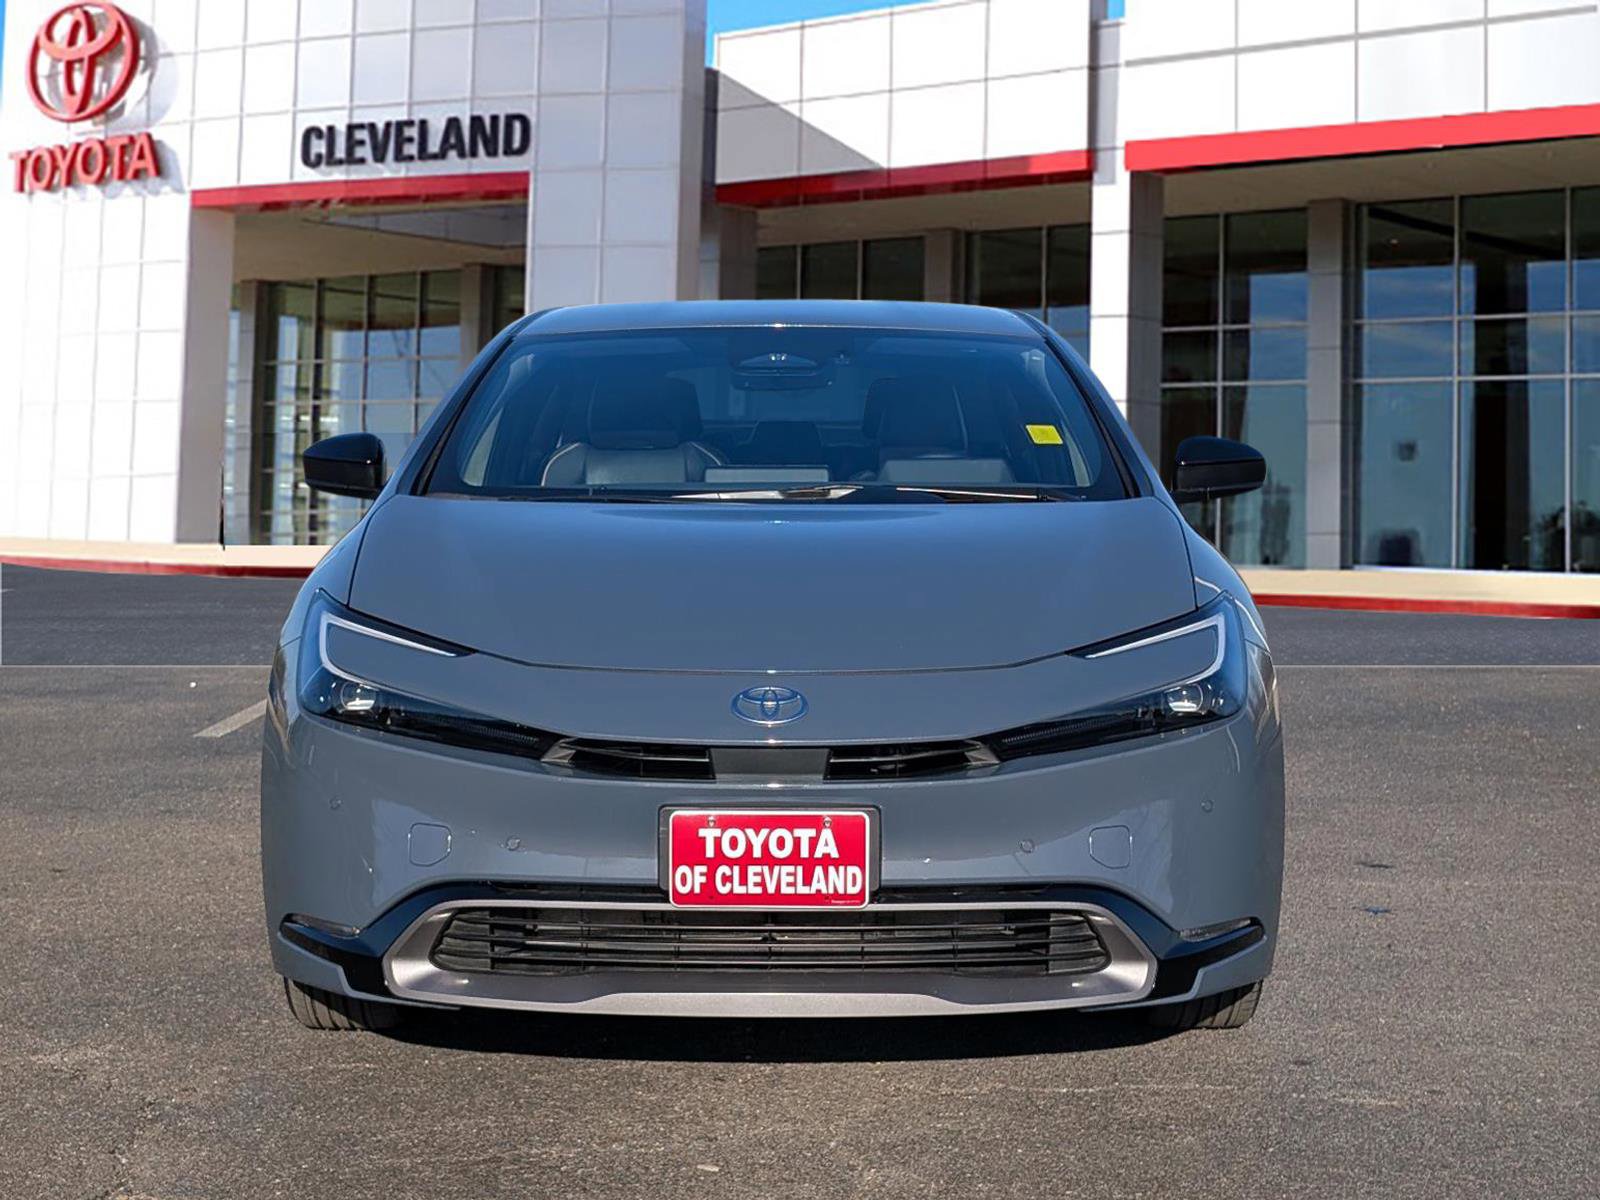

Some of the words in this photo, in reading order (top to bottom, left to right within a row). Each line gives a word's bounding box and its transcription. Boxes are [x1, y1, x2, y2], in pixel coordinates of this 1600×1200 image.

[9, 131, 162, 193] TOYOTA
[300, 112, 531, 169] CLEVELAND
[698, 827, 840, 859] TOYOTA
[674, 864, 708, 895] OF
[715, 864, 863, 895] CLEVELAND
